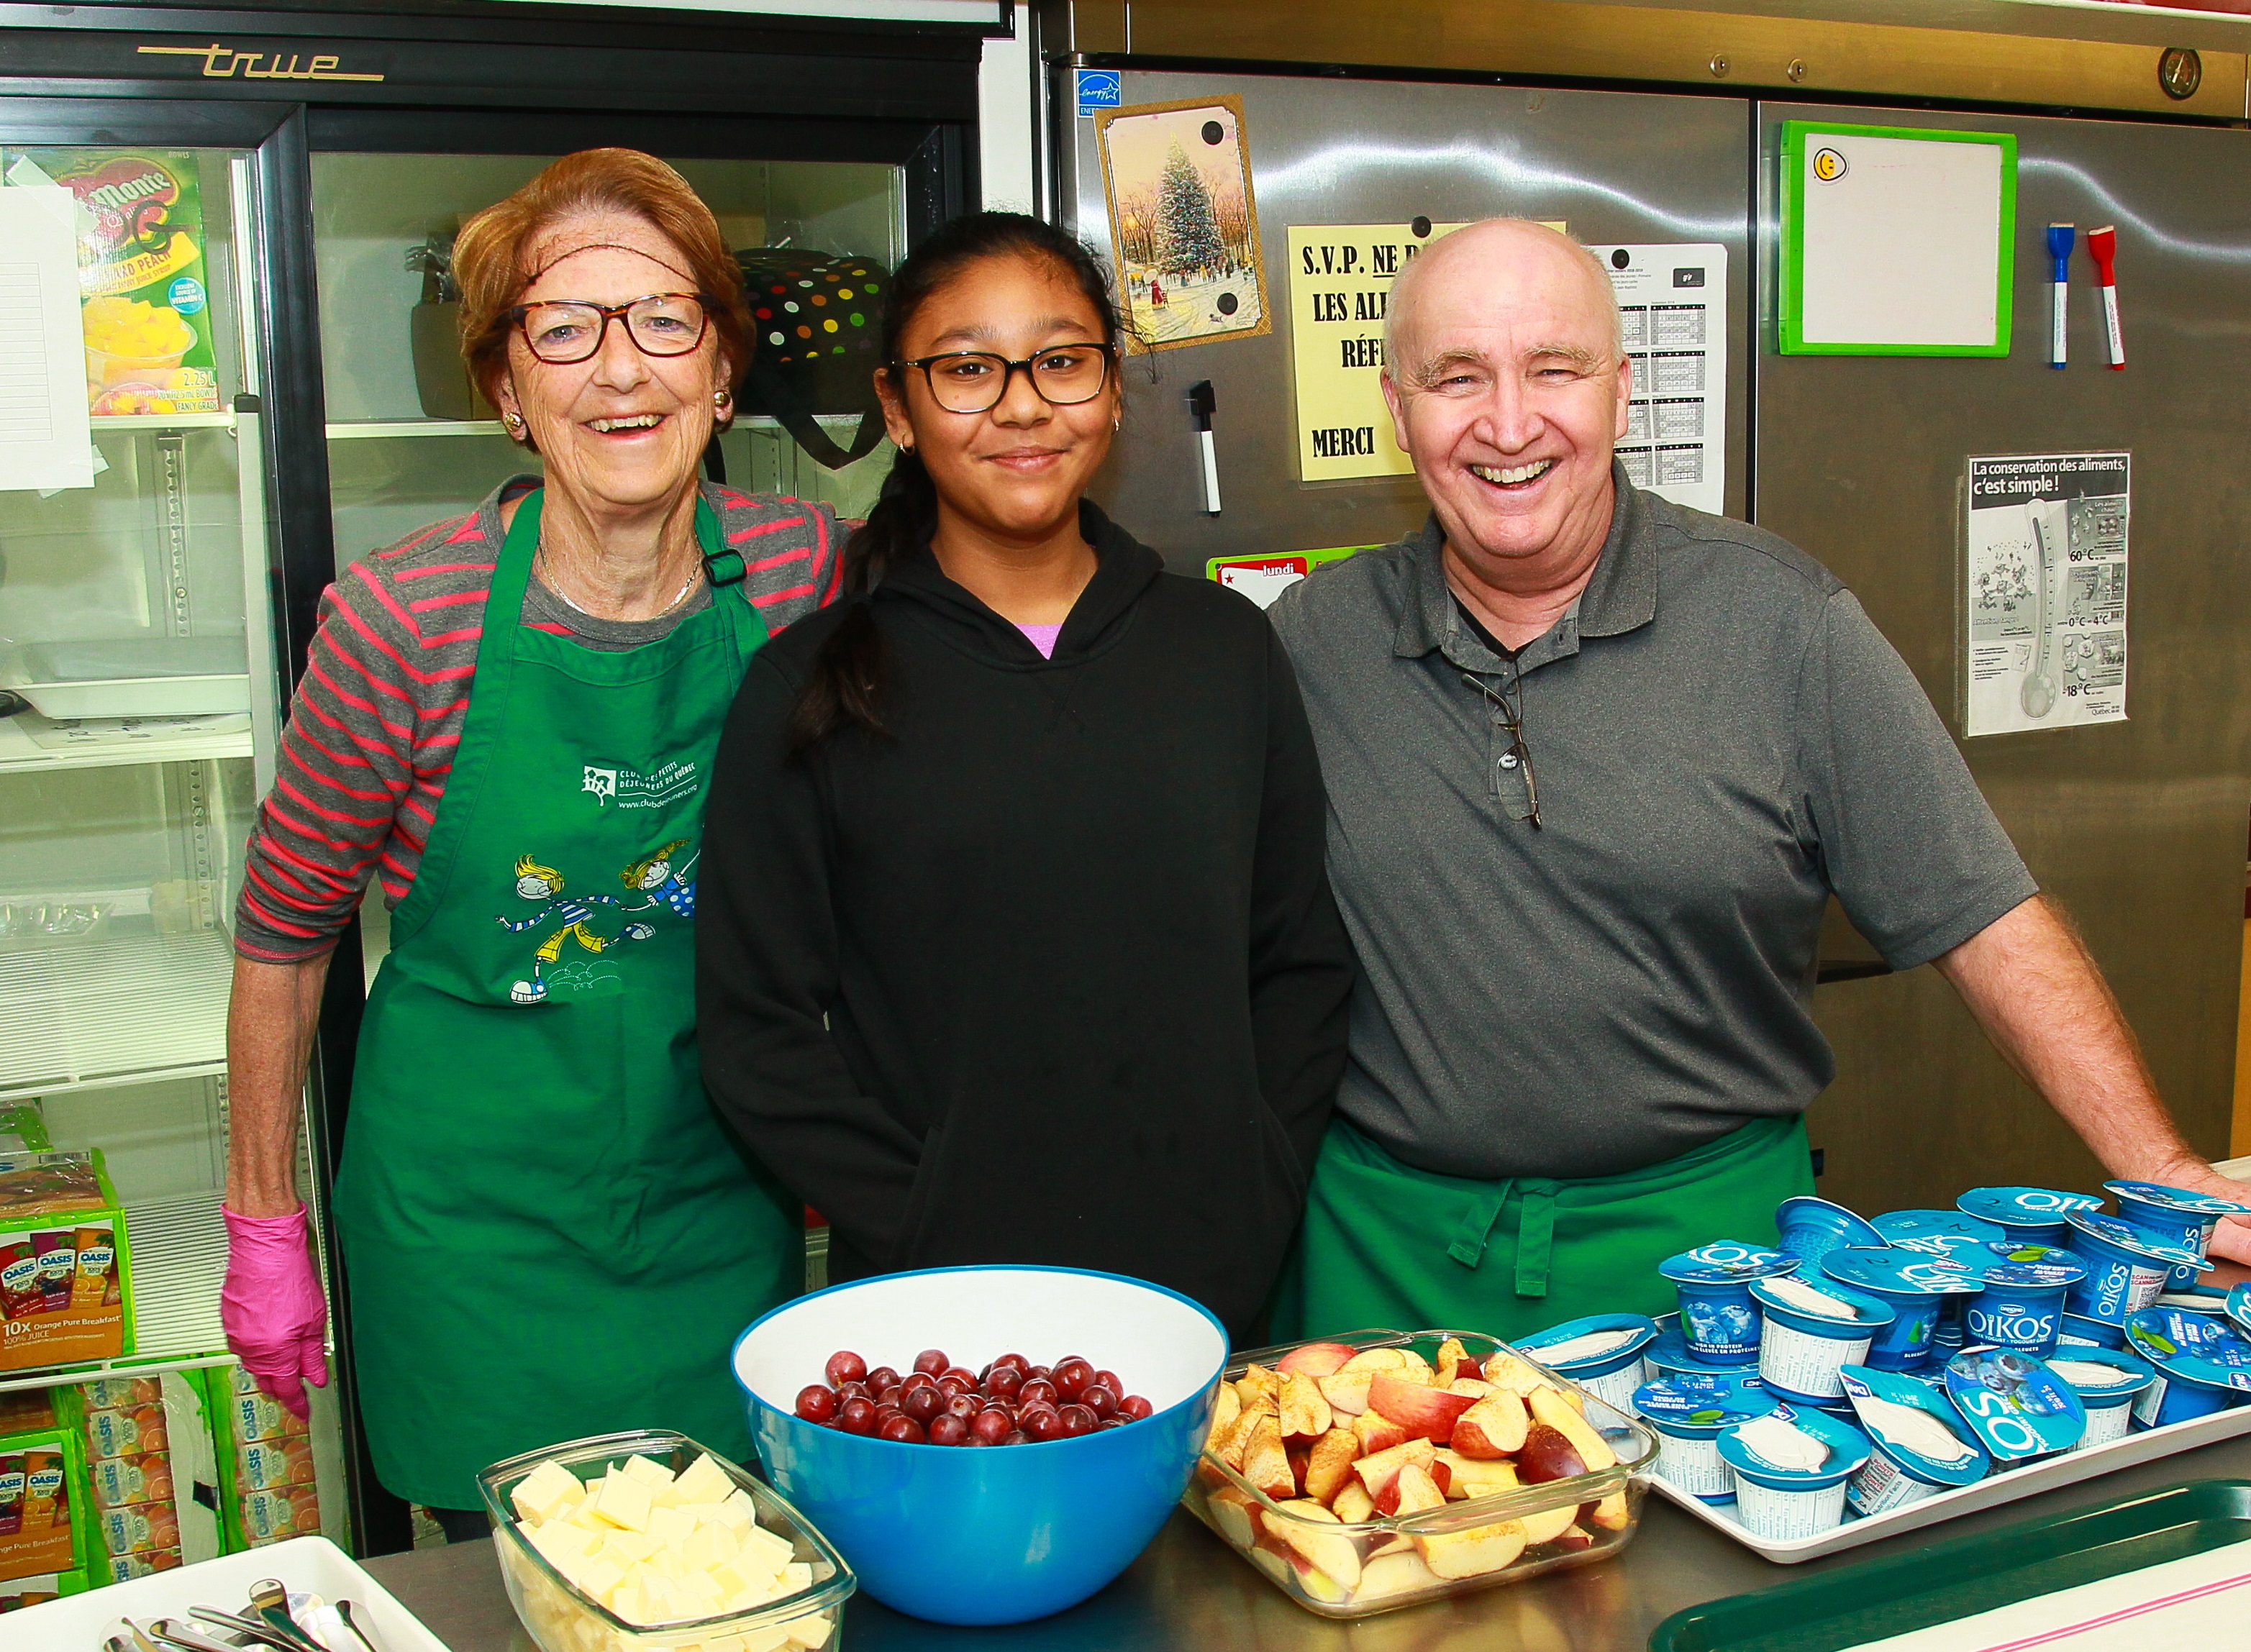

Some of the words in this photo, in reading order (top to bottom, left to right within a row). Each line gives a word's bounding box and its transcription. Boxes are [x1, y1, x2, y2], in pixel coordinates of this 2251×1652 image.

[137, 43, 384, 81] true
[88, 172, 170, 209] Monte
[1302, 245, 1365, 275] S.V.P.
[1372, 245, 1399, 274] NE
[171, 295, 197, 305] VITAMIN
[1313, 292, 1348, 322] LES
[183, 373, 206, 386] 2.25
[209, 371, 216, 386] L
[178, 401, 196, 411] FANCY
[1311, 426, 1375, 458] MERCI
[1973, 462, 1987, 475] La
[1988, 460, 2058, 475] conservation
[2059, 459, 2078, 473] des
[2078, 458, 2126, 472] aliments,
[1973, 478, 2006, 495] c'est
[2008, 475, 2053, 496] simple
[2070, 548, 2094, 562] 60°C
[1263, 562, 1294, 577] lundi
[2068, 616, 2085, 627] 0°C
[2093, 615, 2109, 626] 4°C
[619, 779, 663, 790] DÉJEUNERS
[665, 775, 673, 785] DU
[674, 762, 696, 780] QUÉBEC
[658, 761, 678, 777] PETITS
[40, 1254, 73, 1266] OASIS
[81, 1253, 110, 1262] OASIS
[3, 1263, 35, 1280] OASIS
[3, 1321, 32, 1337] 10x
[34, 1320, 62, 1331] Orange
[4, 1336, 27, 1345] 100%
[28, 1331, 50, 1341] JUICE
[241, 1399, 258, 1440] OASIS
[2016, 1413, 2050, 1448] YOGOURT
[248, 1448, 264, 1488] OASIS
[0, 1478, 22, 1489] ASIS
[29, 1474, 60, 1484] OASIS
[1889, 1480, 1903, 1494] Facts
[14, 1541, 32, 1550] Pure
